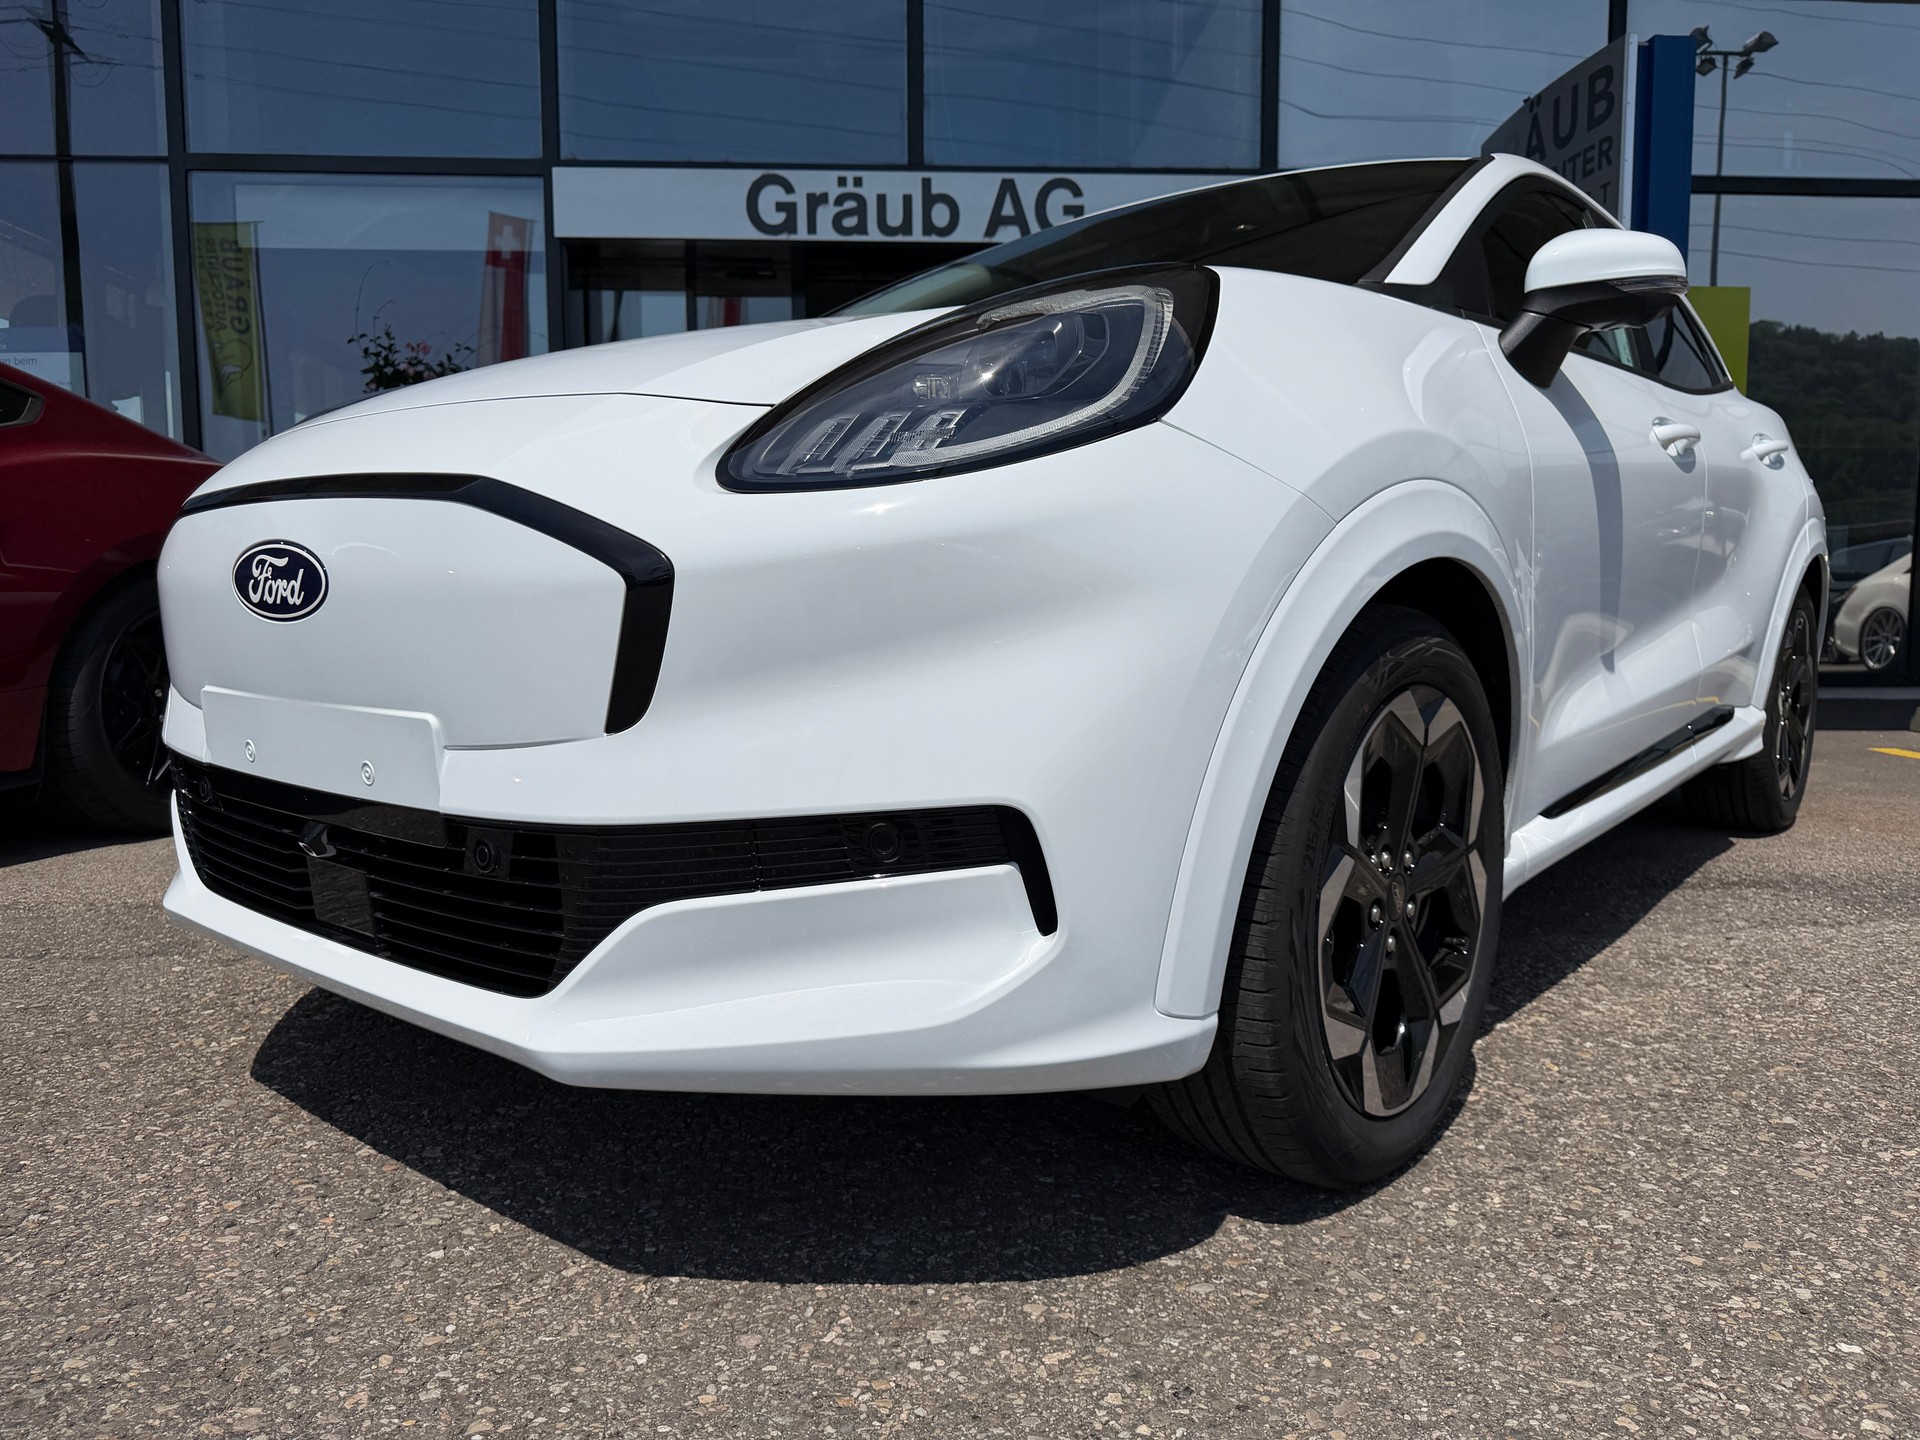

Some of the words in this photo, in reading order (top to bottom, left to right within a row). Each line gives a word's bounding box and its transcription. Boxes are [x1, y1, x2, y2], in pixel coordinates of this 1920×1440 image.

[746, 173, 960, 237] Gräub
[983, 177, 1085, 239] AG
[14, 356, 38, 366] beim
[248, 554, 304, 606] Ford
[1303, 788, 1328, 870] 215/50
